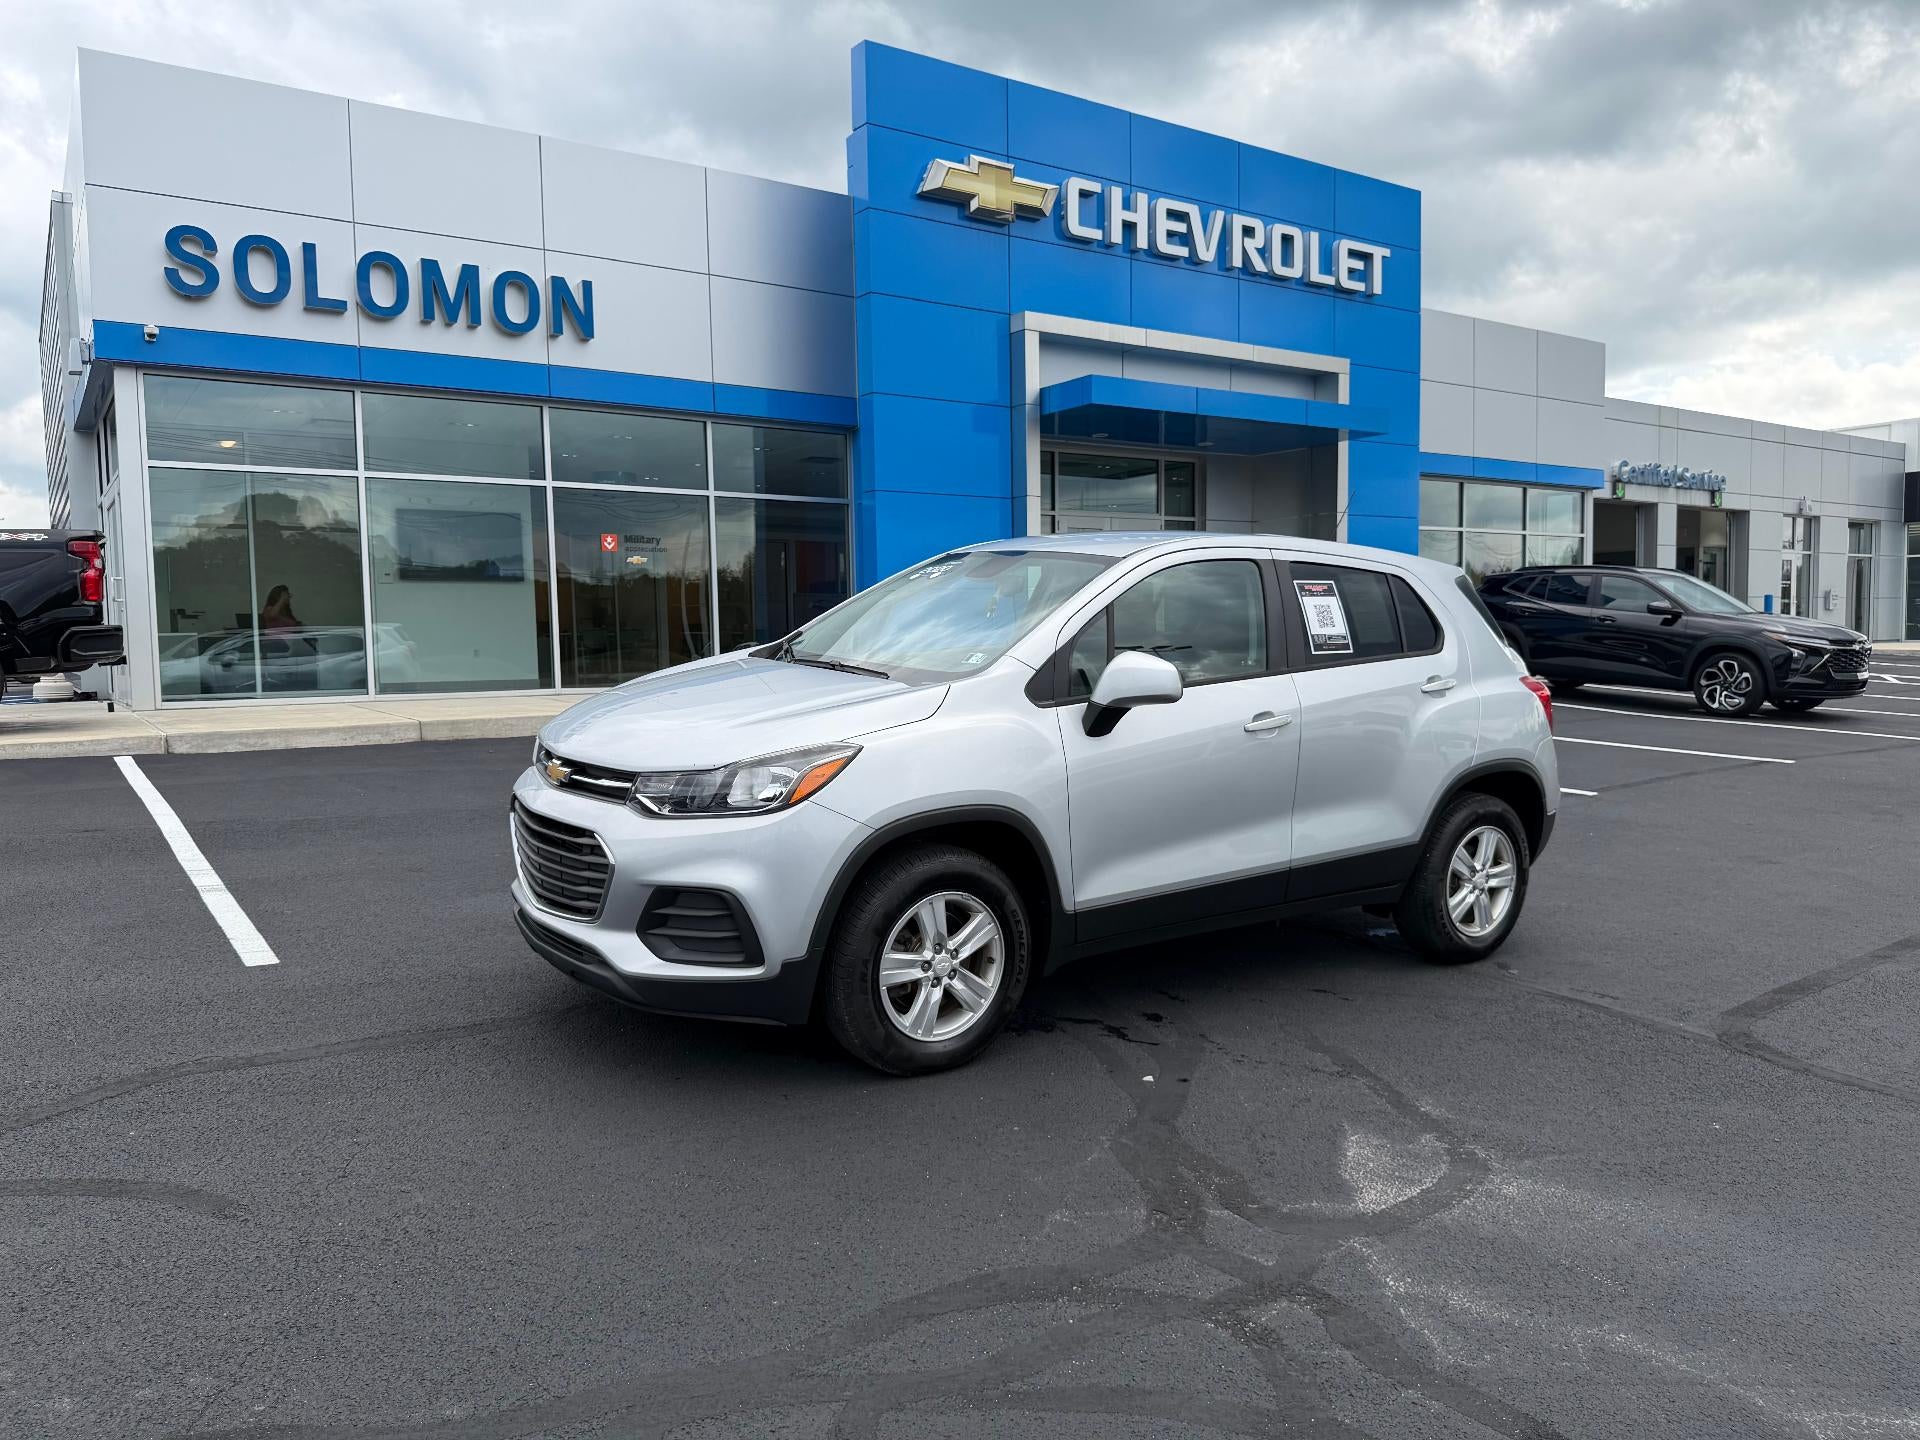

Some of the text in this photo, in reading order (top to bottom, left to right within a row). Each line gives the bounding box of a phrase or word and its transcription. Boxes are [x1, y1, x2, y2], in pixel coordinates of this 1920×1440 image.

[1062, 176, 1391, 296] CHEVROLET
[164, 224, 595, 342] SOLOMON
[1617, 460, 1727, 491] Certified Service
[624, 535, 661, 545] Military
